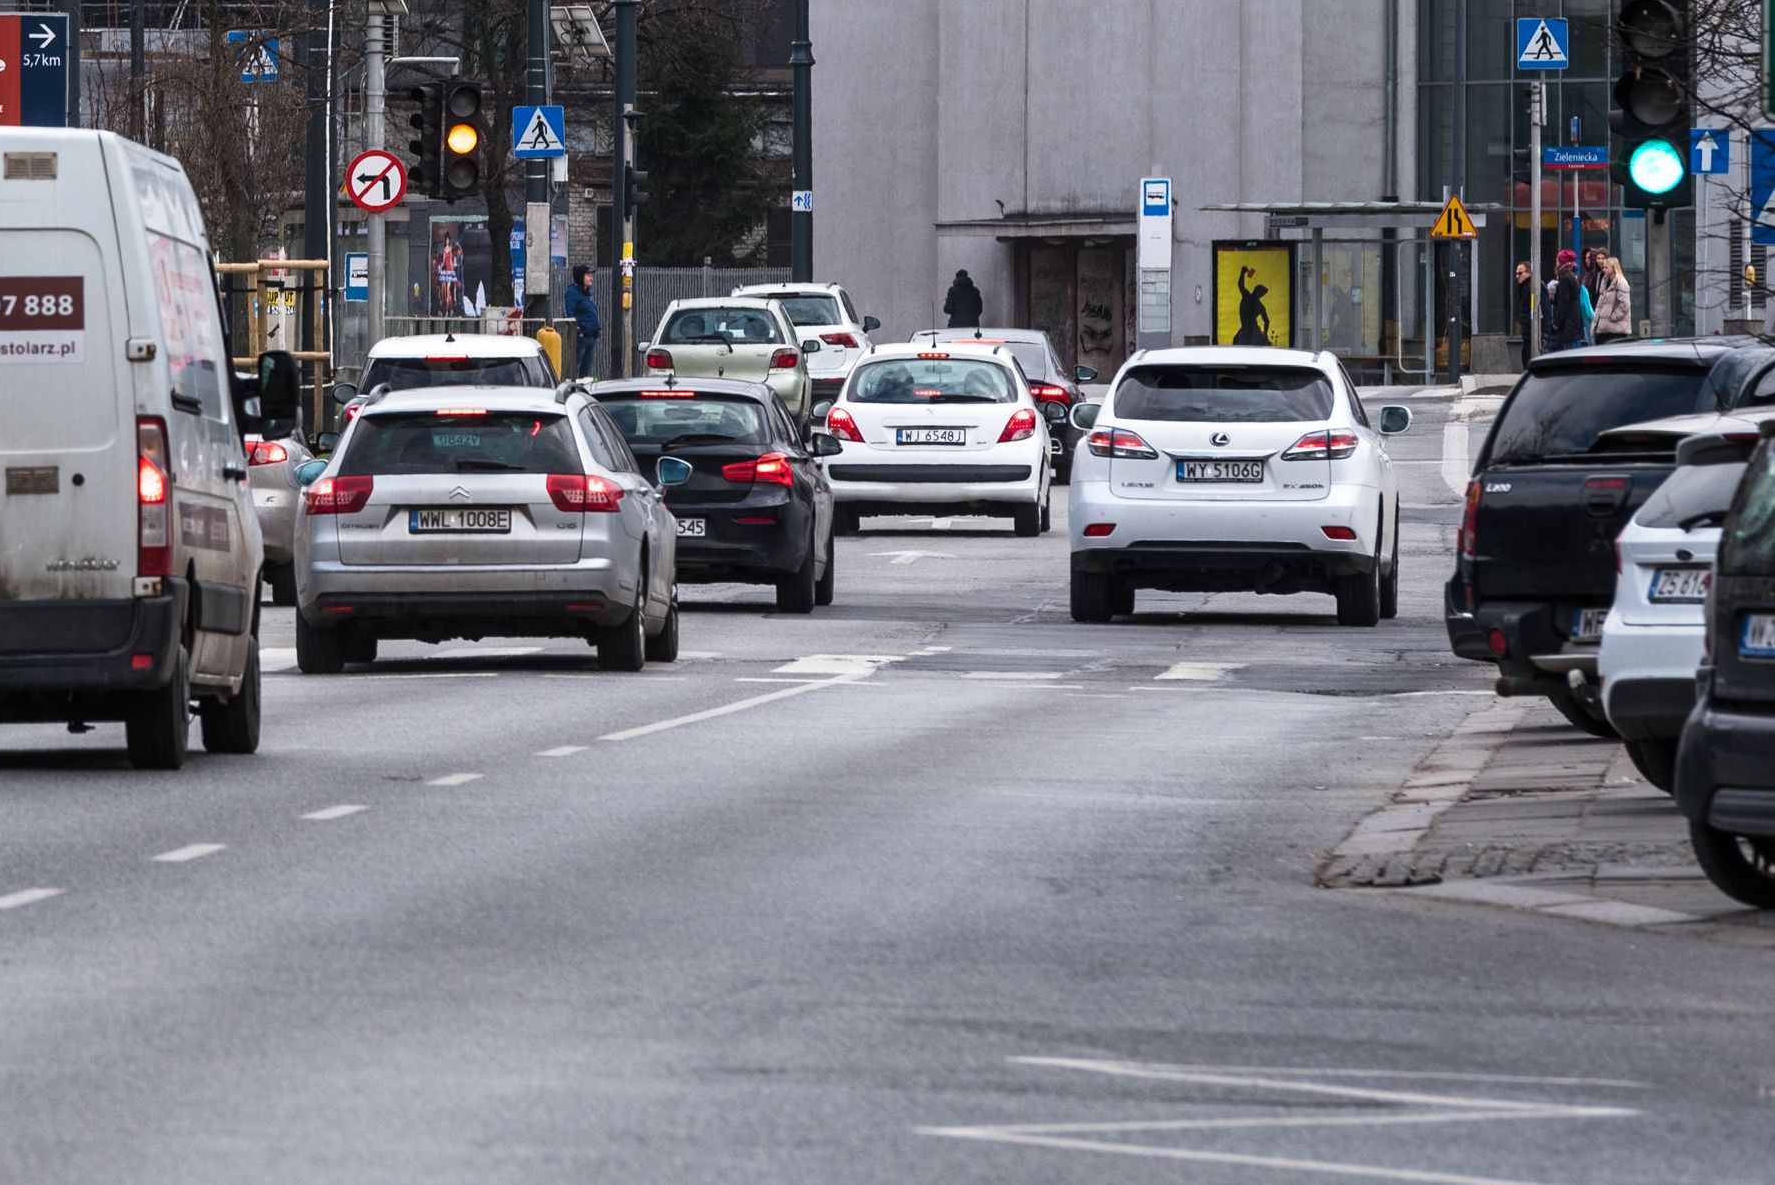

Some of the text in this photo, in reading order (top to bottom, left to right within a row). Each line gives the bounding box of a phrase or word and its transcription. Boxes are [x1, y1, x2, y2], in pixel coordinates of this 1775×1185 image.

[1554, 152, 1598, 162] Zieleniecka
[24, 295, 74, 316] 888
[925, 430, 962, 443] 6548J
[1186, 463, 1261, 478] WY 5106G
[419, 511, 508, 528] WWL 1008E
[678, 520, 704, 535] 545
